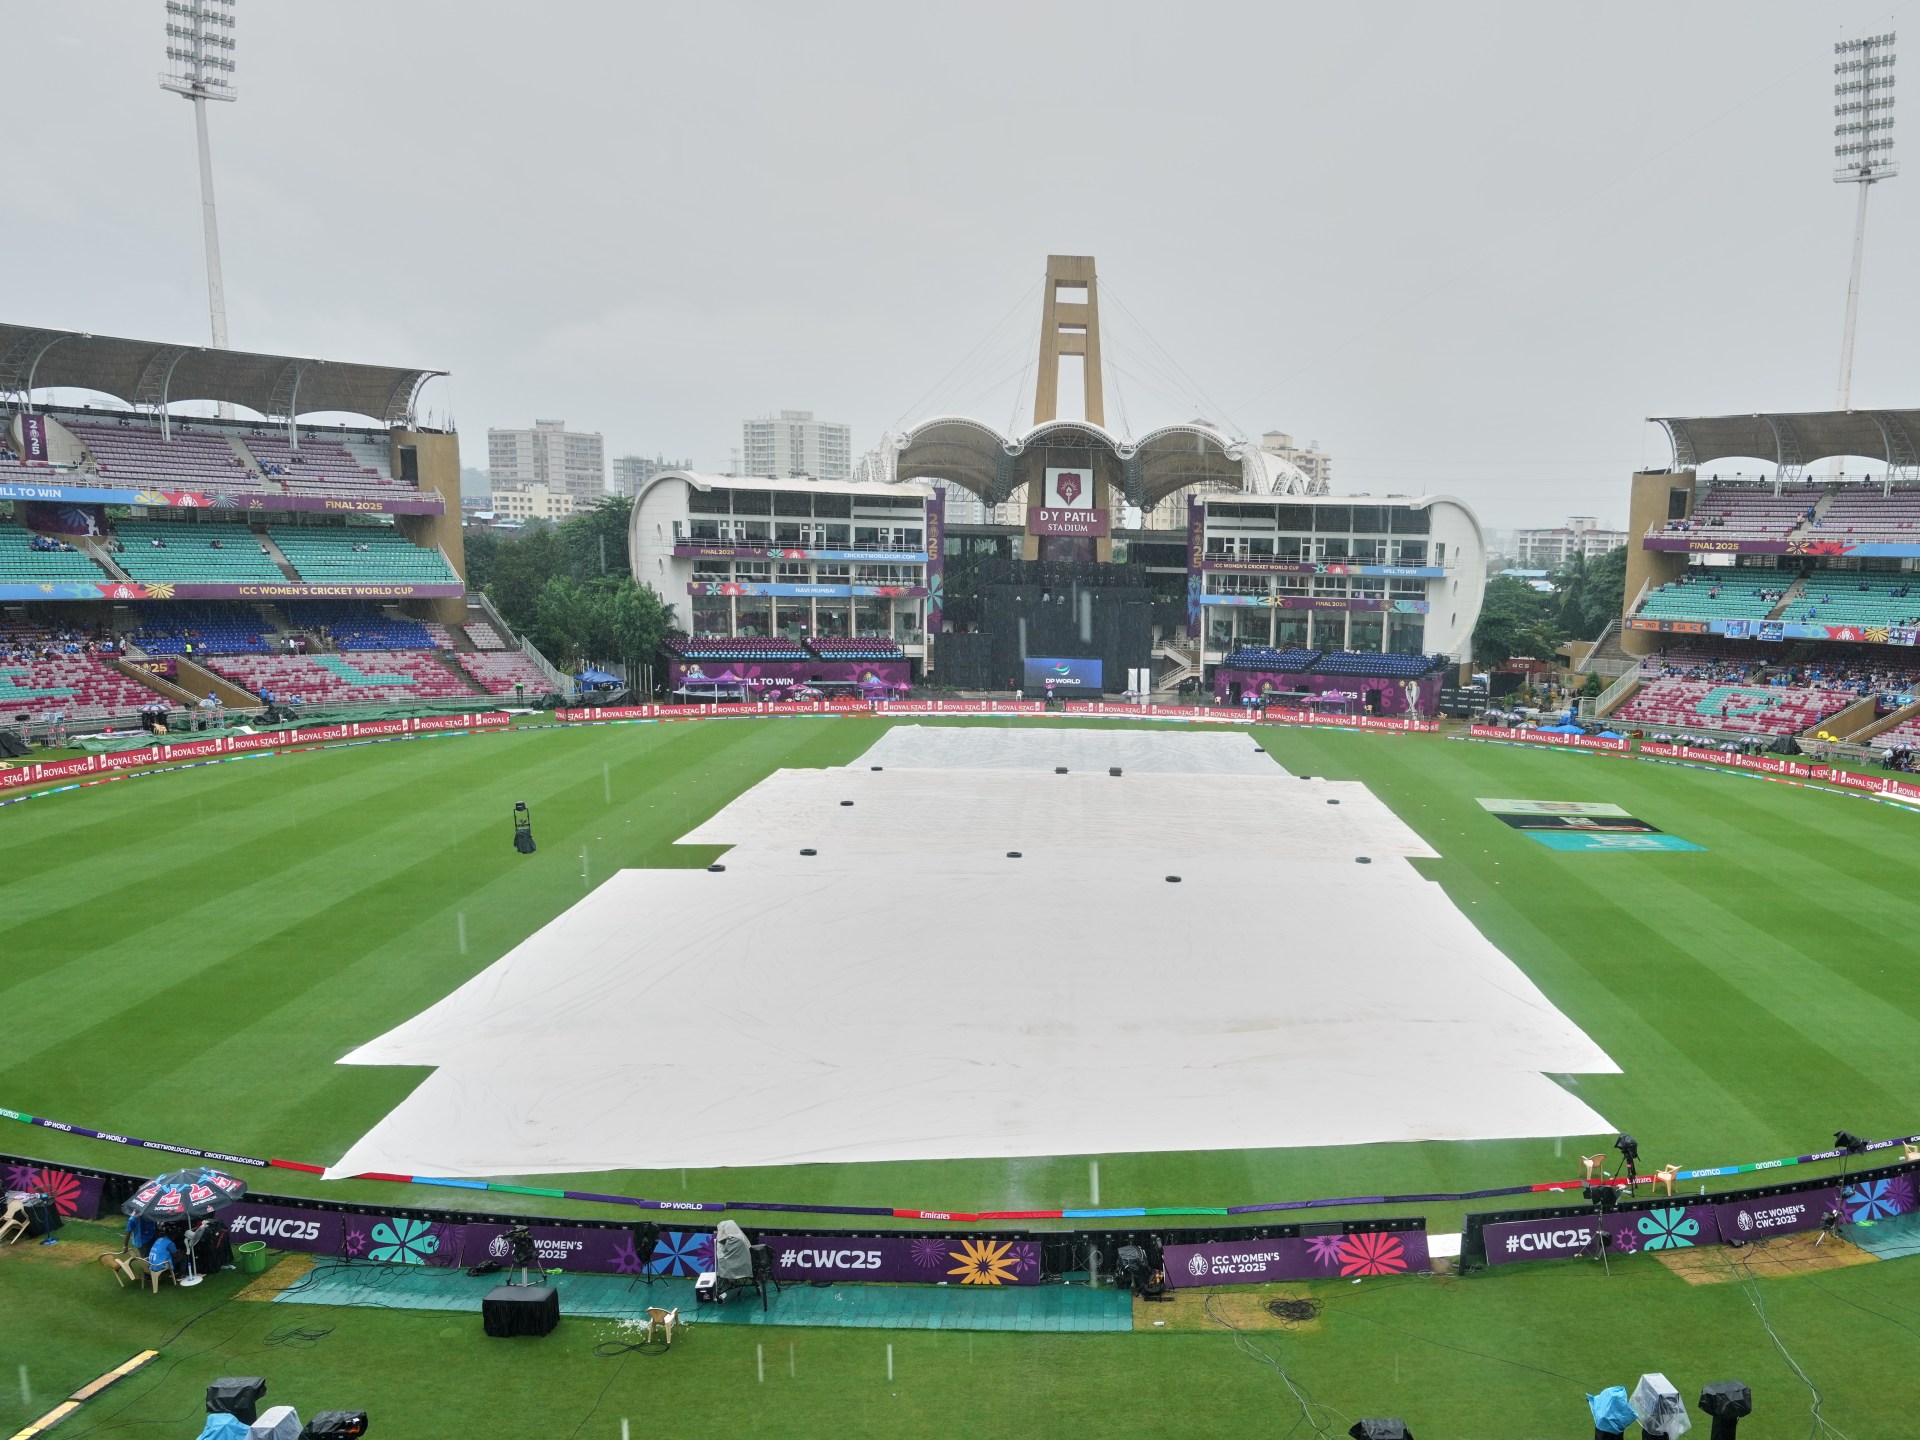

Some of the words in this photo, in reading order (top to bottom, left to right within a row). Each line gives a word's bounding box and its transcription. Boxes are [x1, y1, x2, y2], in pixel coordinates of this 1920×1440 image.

[18, 488, 35, 497] TO
[38, 489, 61, 498] WIN
[325, 501, 355, 509] FINAL
[356, 502, 383, 510] 2025
[1040, 511, 1049, 521] D
[1051, 511, 1060, 521] Y
[1064, 512, 1098, 523] PATIL
[1047, 523, 1088, 532] STADIUM
[1689, 542, 1714, 550] FINAL
[1715, 542, 1739, 550] 2025
[844, 552, 916, 560] CRICKETWORLDCUP.COM
[239, 586, 257, 595] ICC
[259, 586, 308, 595] WOMEN'S
[310, 587, 353, 595] CRICKET
[355, 587, 392, 595] WORLD
[394, 587, 414, 595] CUP
[774, 678, 794, 686] WIN
[740, 705, 757, 713] STAG
[421, 720, 444, 729] ROYAL
[445, 719, 463, 728] STAG
[482, 716, 505, 724] ROYAL
[1315, 716, 1335, 724] ROYAL
[1336, 717, 1351, 725] STAG
[1367, 720, 1387, 728] ROYAL
[1388, 721, 1403, 729] STAG
[360, 725, 382, 734] ROYAL
[384, 724, 401, 733] STAG
[1473, 728, 1494, 736] ROYAL
[1495, 730, 1510, 738] STAG
[299, 731, 323, 741] ROYAL
[323, 730, 341, 739] STAG
[1526, 733, 1547, 742] ROYAL
[1548, 735, 1563, 744] STAG
[235, 738, 259, 748] ROYAL
[260, 737, 278, 746] STAG
[1580, 739, 1601, 747] ROYAL
[1602, 741, 1618, 749] STAG
[172, 747, 197, 757] ROYAL
[197, 744, 215, 754] STAG
[1655, 747, 1672, 755] STAG
[108, 756, 132, 766] ROYAL
[133, 753, 152, 763] STAG
[1688, 751, 1709, 760] ROYAL
[1709, 754, 1726, 763] STAG
[43, 766, 68, 777] ROYAL
[69, 763, 88, 773] STAG
[1742, 759, 1762, 769] ROYAL
[1762, 762, 1779, 771] STAG
[4, 773, 23, 783] STAG
[1846, 776, 1866, 787] ROYAL
[1866, 780, 1882, 790] STAG
[1898, 787, 1918, 797] ROYAL
[52, 1122, 72, 1131] WORLD
[105, 1134, 127, 1144] WORLD
[143, 1141, 201, 1156] CRICKETWORLDCUP.COM
[1874, 1140, 1894, 1150] WORLD
[204, 1151, 265, 1167] CRICKETWORLDCUP.COM
[1811, 1153, 1823, 1161] DP
[1823, 1150, 1841, 1160] WORLD
[1755, 1160, 1782, 1170] aramco
[1691, 1168, 1721, 1178] aramco
[660, 1202, 673, 1210] DP
[674, 1202, 703, 1210] WORLD
[920, 1211, 950, 1220] Emirates
[1753, 1210, 1770, 1220] ICC
[1771, 1204, 1806, 1217] WOMEN'S
[1756, 1219, 1775, 1229] CWC
[1775, 1214, 1797, 1225] 2025
[230, 1215, 320, 1240] #CWC25
[533, 1240, 583, 1250] WOMEN'S
[1506, 1228, 1592, 1253] #CWC25
[538, 1250, 567, 1259] 2025
[780, 1249, 882, 1269] #CWC25
[1211, 1255, 1229, 1265] ICC
[1231, 1252, 1280, 1264] WOMEN'S
[1211, 1264, 1236, 1275] CWC
[1238, 1262, 1267, 1273] 2025
